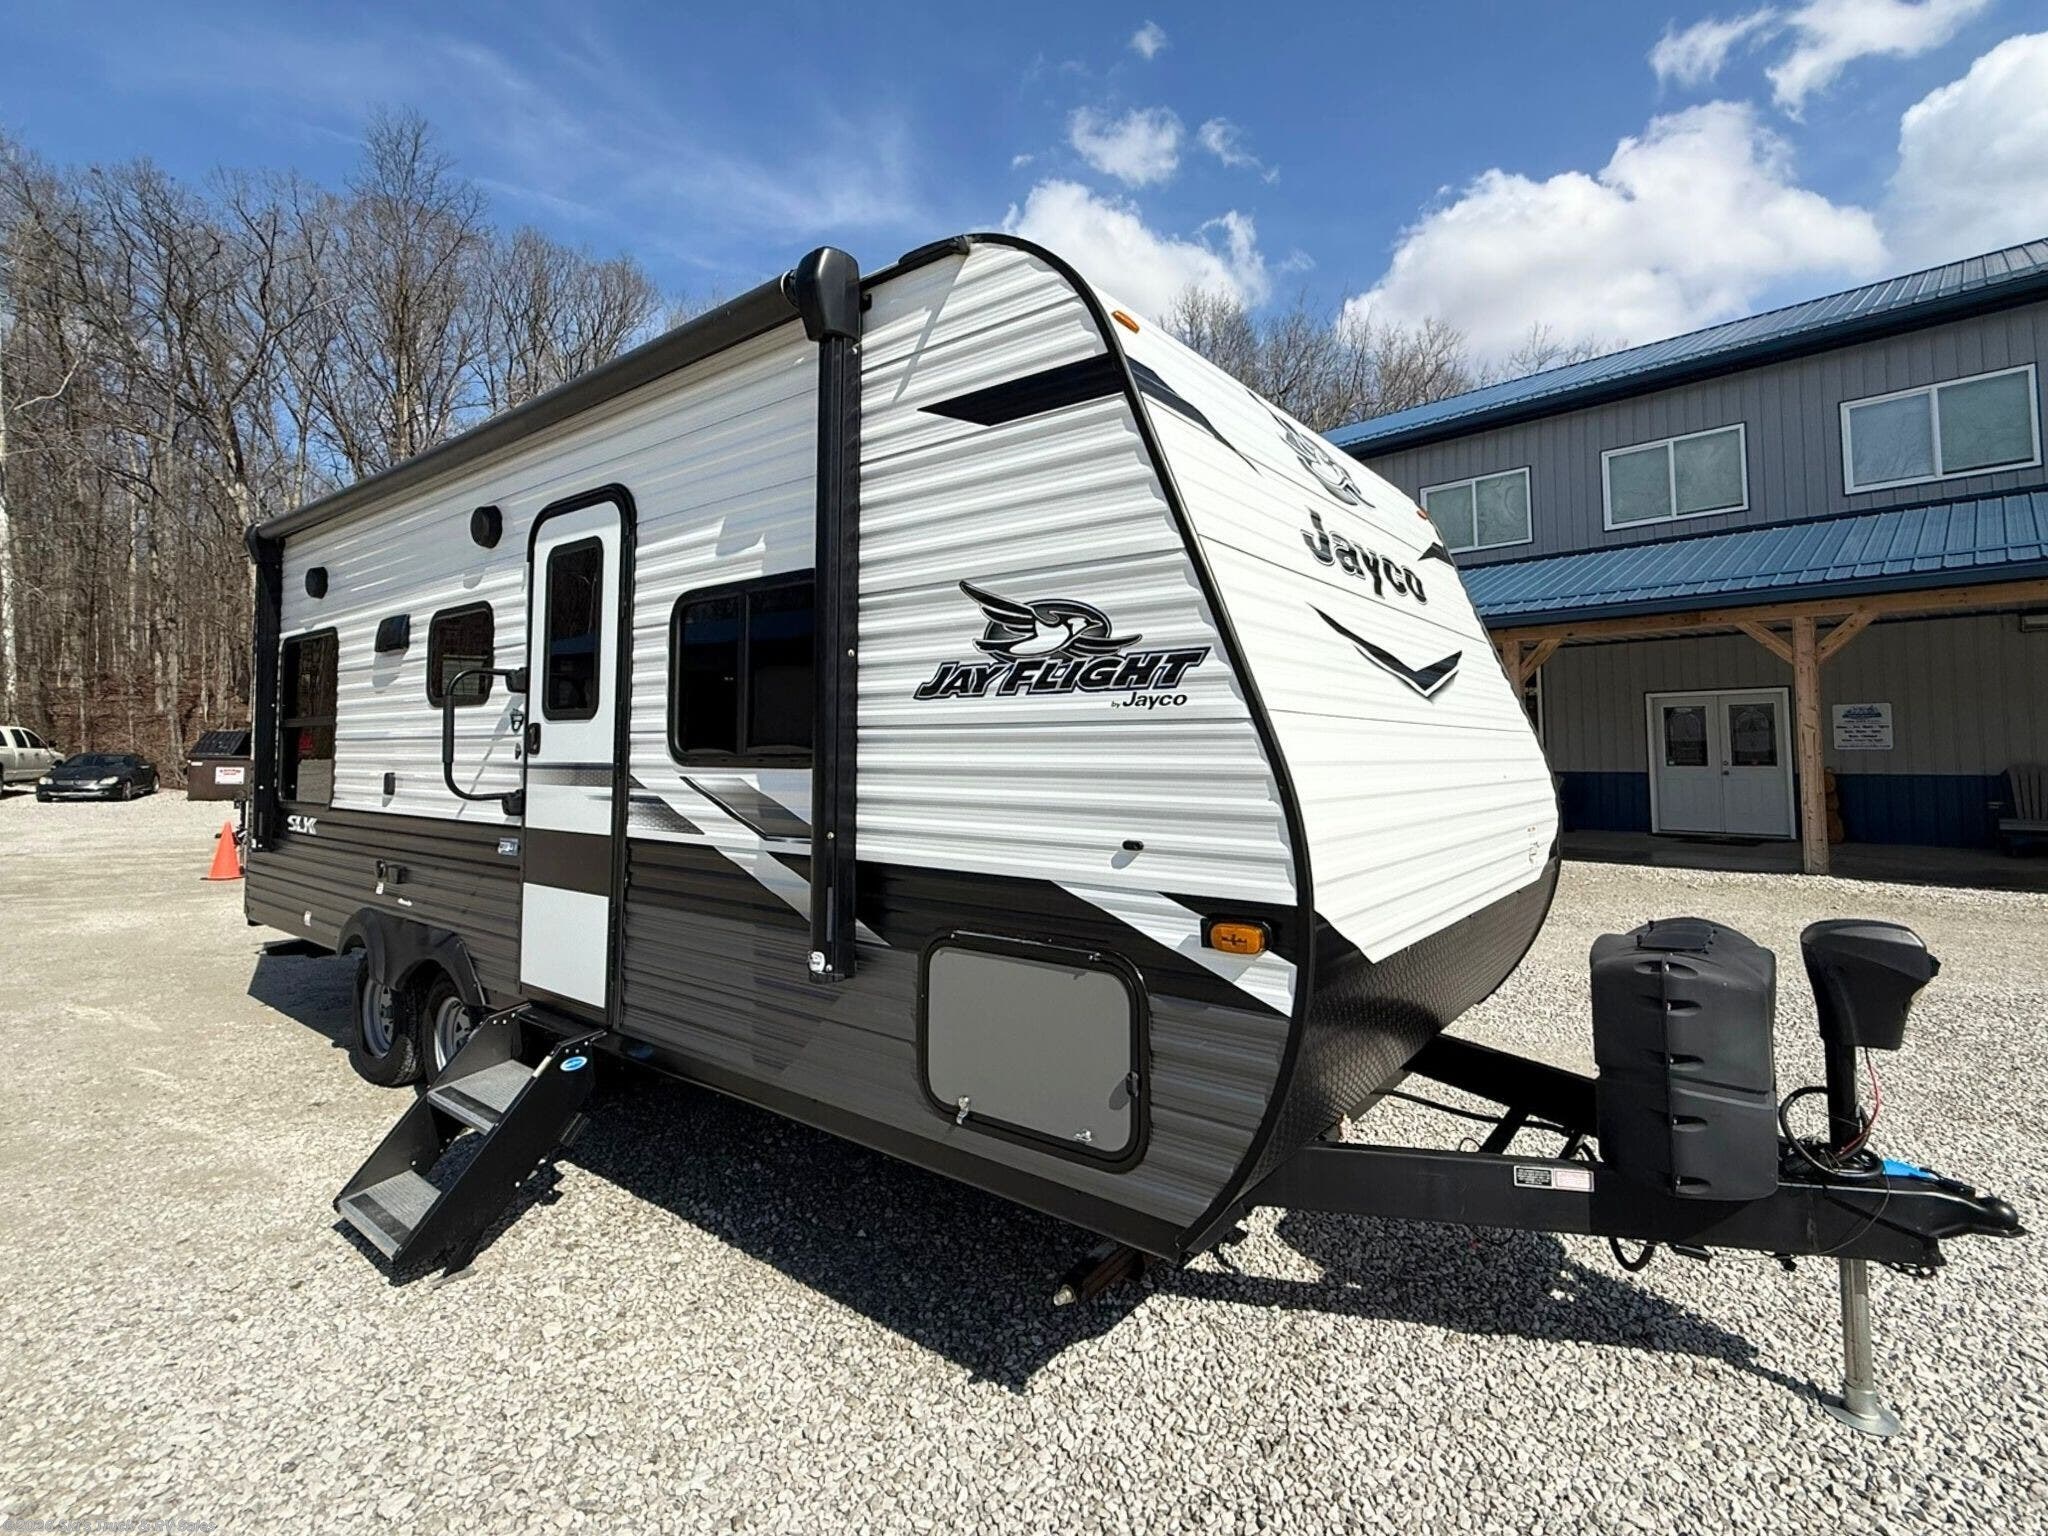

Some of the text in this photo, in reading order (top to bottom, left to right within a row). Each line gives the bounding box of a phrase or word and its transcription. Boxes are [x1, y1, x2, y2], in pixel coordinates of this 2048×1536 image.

[1301, 505, 1428, 605] Jayco
[913, 647, 1210, 699] JAY FLIGHT
[1111, 691, 1188, 710] by Jayco
[287, 814, 318, 835] SLK
